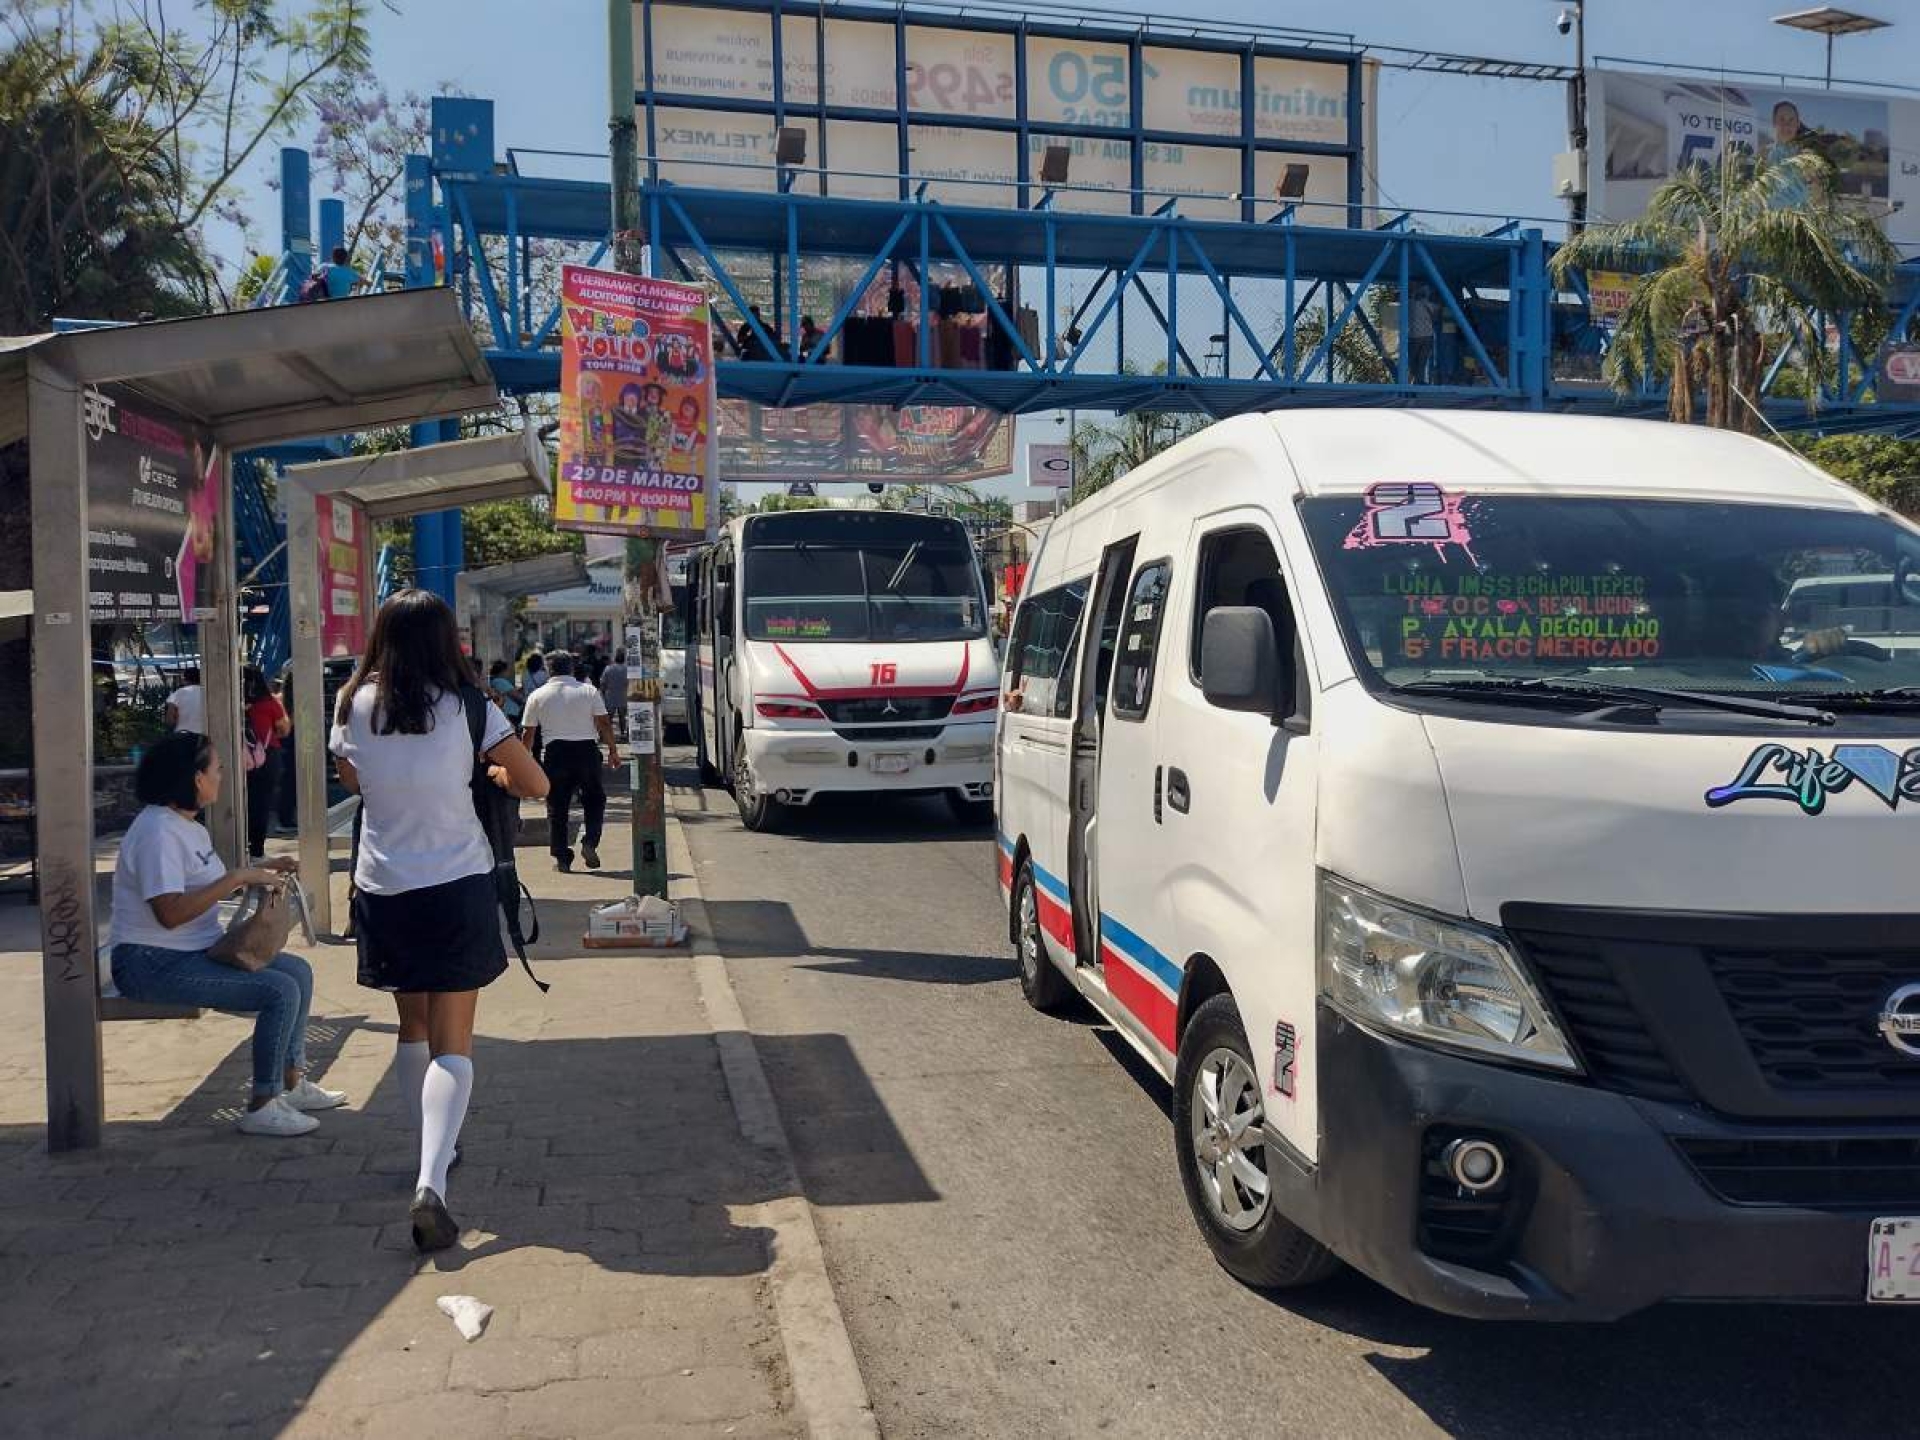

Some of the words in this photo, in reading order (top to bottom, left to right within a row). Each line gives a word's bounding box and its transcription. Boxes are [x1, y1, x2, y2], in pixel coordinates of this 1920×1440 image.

[1679, 112, 1701, 129] YO
[1704, 116, 1753, 135] TENGO
[570, 273, 648, 295] CUERNAVACA
[649, 286, 703, 304] MORELOS
[578, 287, 636, 306] AUDITORIO
[637, 297, 651, 308] DE
[652, 299, 665, 311] LA
[571, 466, 596, 481] 29
[601, 468, 628, 484] DE
[631, 471, 699, 491] MARZO
[604, 489, 627, 503] PM
[630, 490, 640, 502] Y
[669, 495, 690, 507] PM
[1365, 481, 1451, 540] 2
[1403, 595, 1489, 615] TZOC
[1443, 616, 1533, 639] AYALA
[1540, 616, 1660, 639] DEGOLLADO
[1440, 638, 1532, 660] FRACC
[1536, 639, 1660, 658] MERCADO
[1704, 743, 1853, 816] Life
